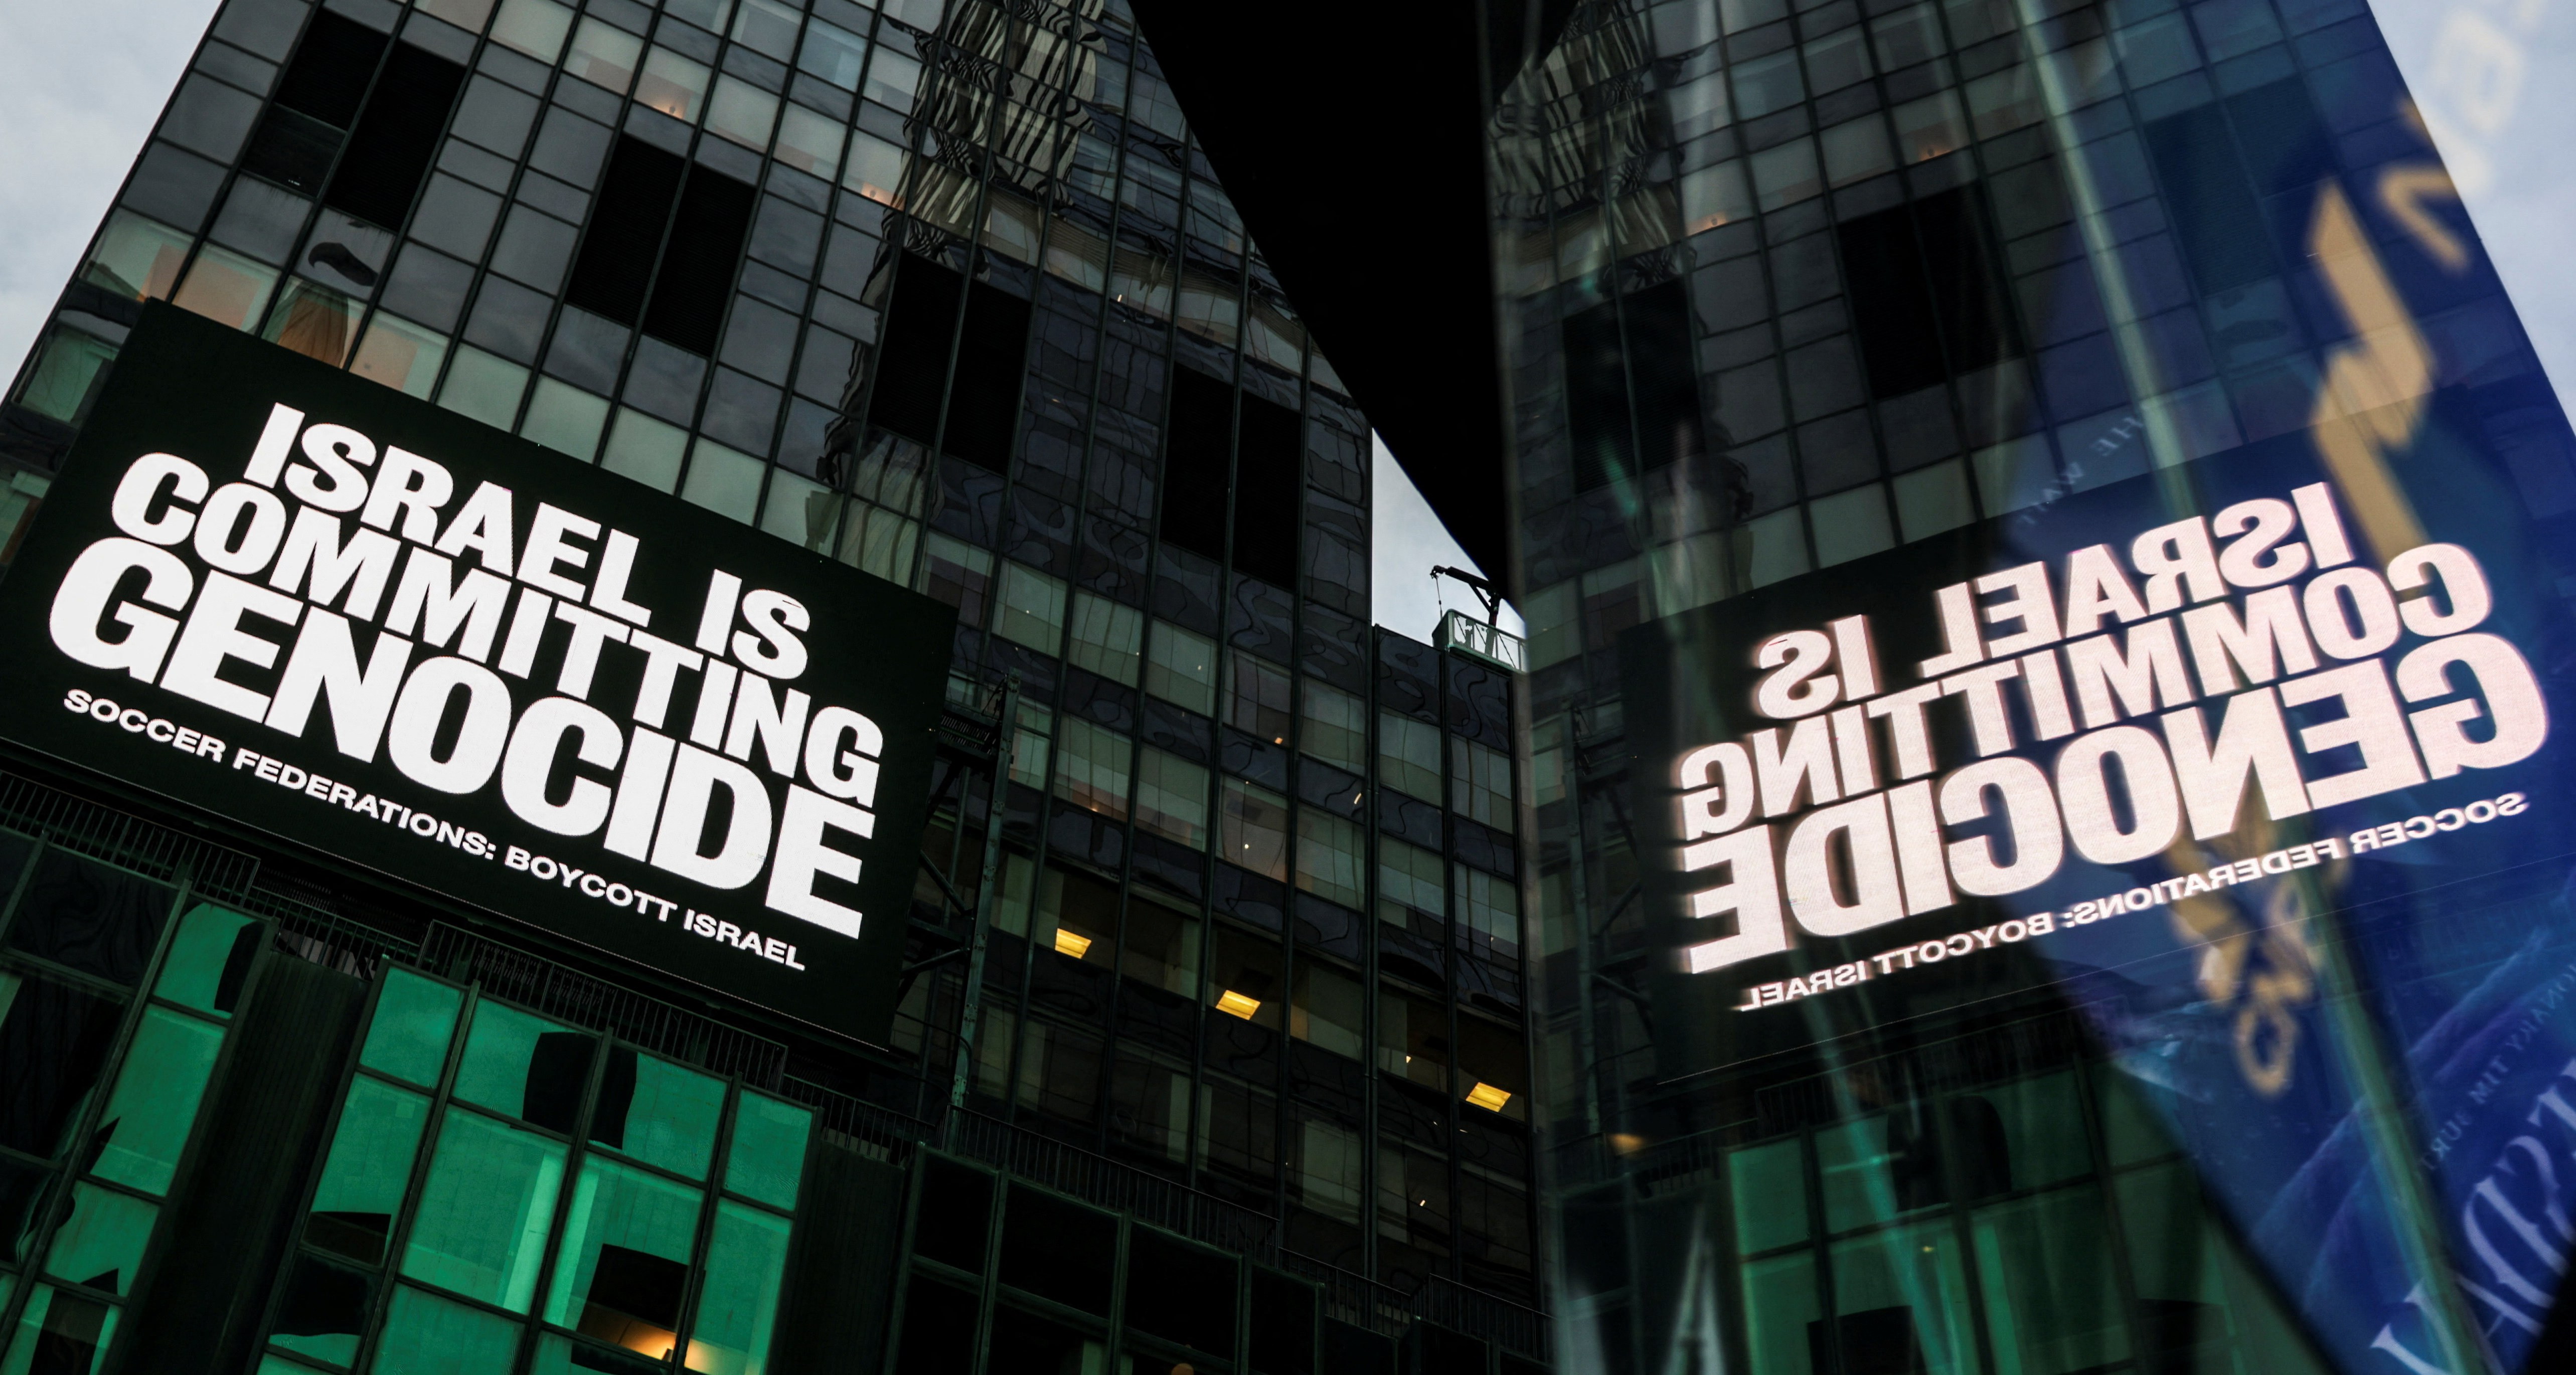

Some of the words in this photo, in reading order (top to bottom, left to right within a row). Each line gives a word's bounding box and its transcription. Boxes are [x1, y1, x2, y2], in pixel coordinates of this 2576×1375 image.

[112, 453, 883, 808] COMMITTING
[244, 403, 651, 627] ISRAEL
[696, 569, 810, 679] IS
[50, 537, 875, 939] GENOCIDE
[64, 690, 226, 762] SOCCER
[233, 748, 496, 860] FEDERATIONS:
[505, 845, 678, 922] BOYCOTT
[684, 909, 805, 971] ISRAEL
